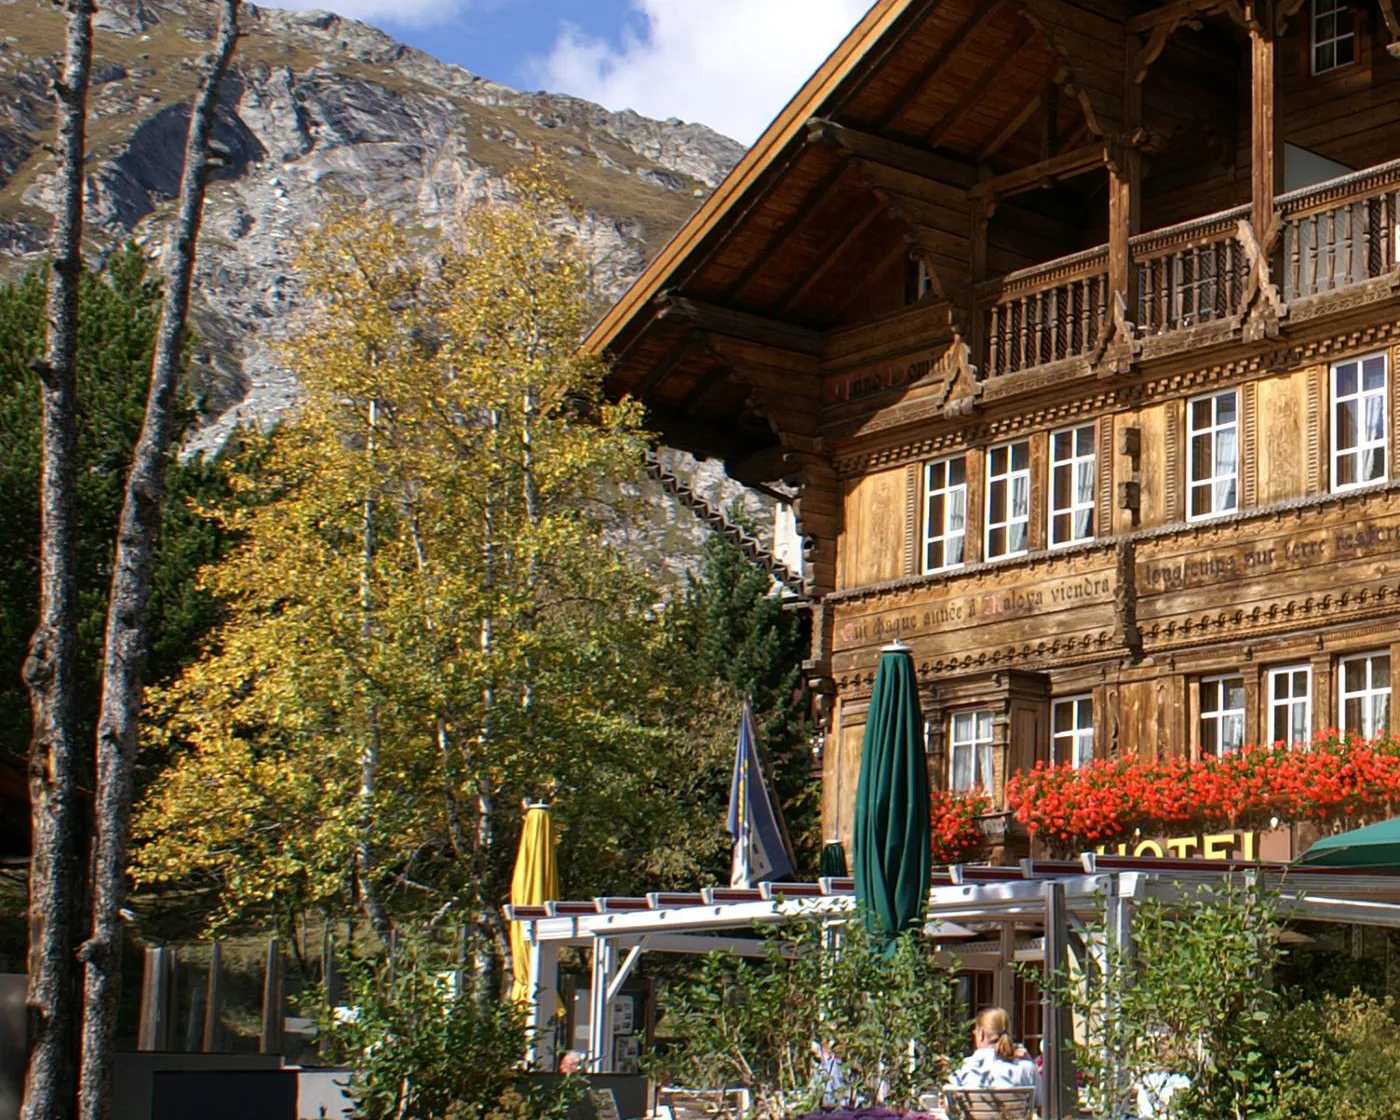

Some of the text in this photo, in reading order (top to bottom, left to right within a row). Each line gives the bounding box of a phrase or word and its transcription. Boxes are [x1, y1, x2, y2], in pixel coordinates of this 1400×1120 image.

[876, 352, 945, 390] Domin
[984, 589, 1042, 614] Maloya
[1050, 577, 1110, 603] viendra
[1244, 549, 1276, 568] sur
[1283, 540, 1327, 561] terre
[1096, 832, 1254, 861] TEL
